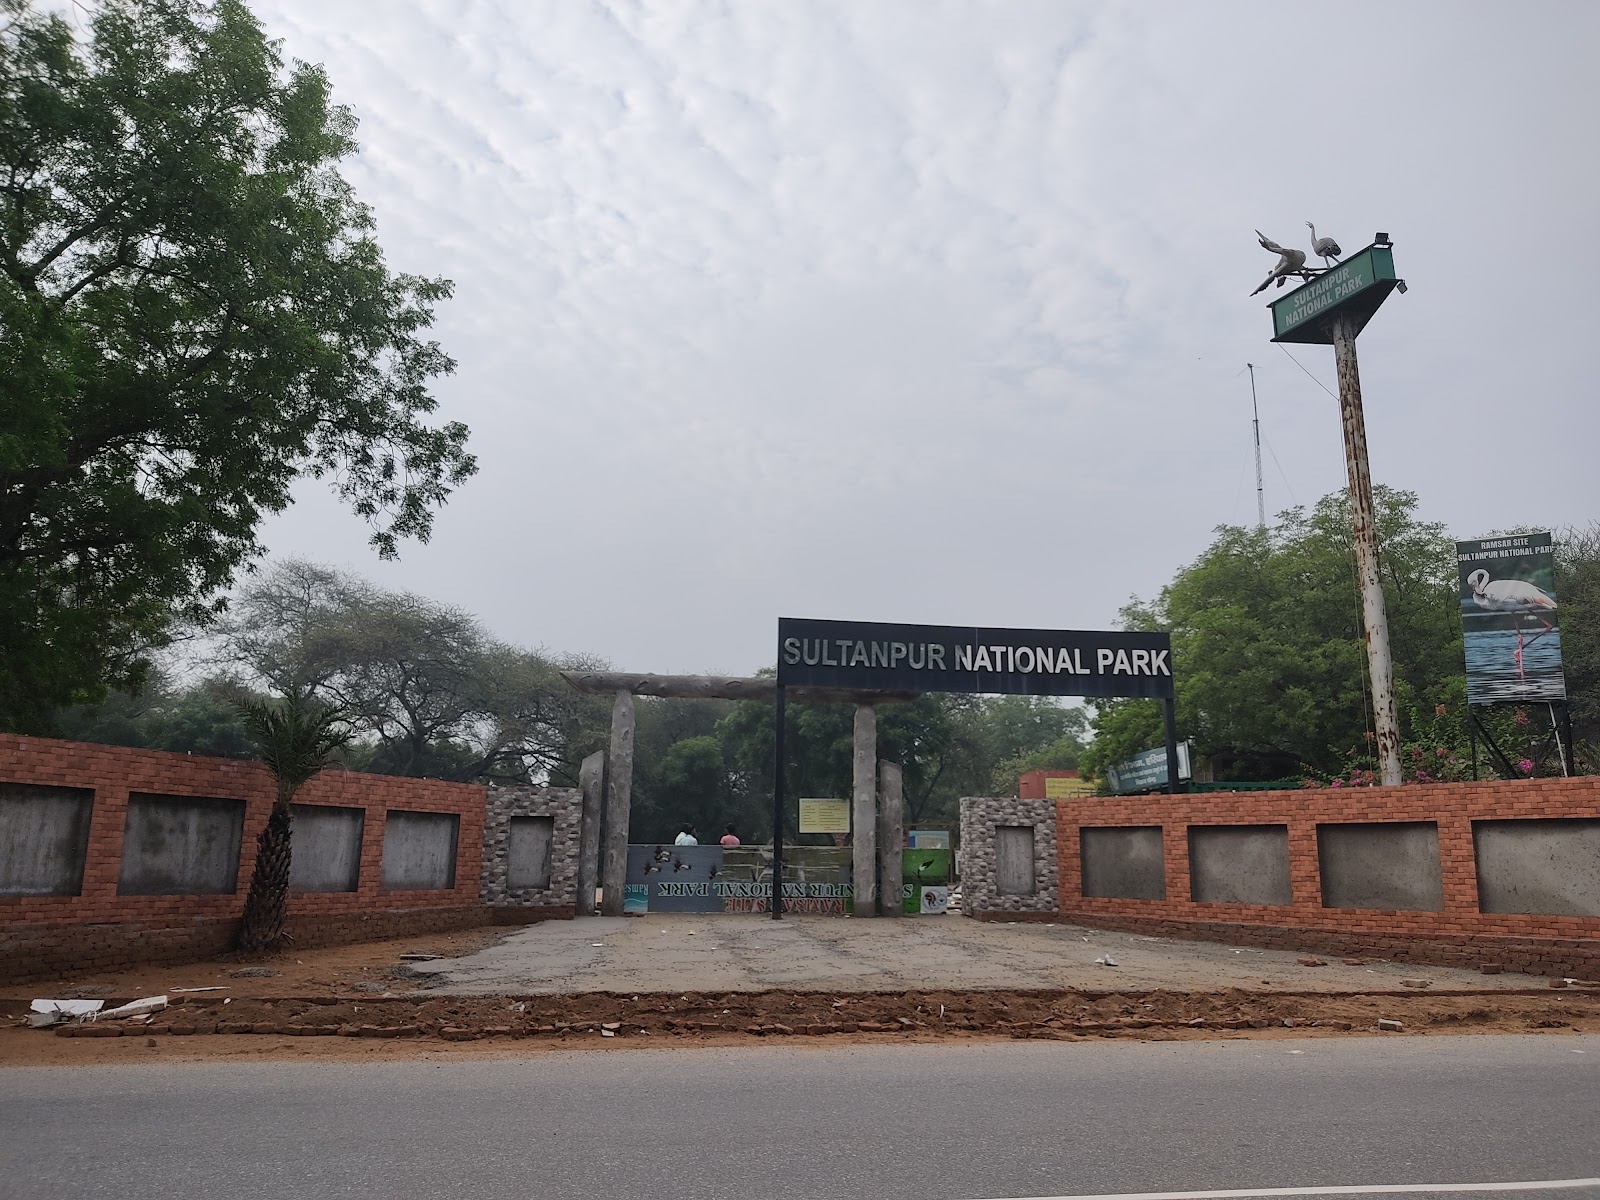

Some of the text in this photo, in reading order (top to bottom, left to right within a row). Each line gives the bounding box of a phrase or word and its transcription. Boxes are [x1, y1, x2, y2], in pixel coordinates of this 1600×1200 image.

[1294, 267, 1349, 308] SULTANPUR
[1285, 274, 1363, 327] NATIONAL PARK
[1481, 537, 1529, 550] RAMSAR SITE
[1458, 550, 1498, 561] SULTANPUR
[1500, 546, 1533, 557] NATIONAL
[783, 637, 1171, 676] SULTANPUR NATIONAL PARK
[658, 881, 709, 897] PARK
[713, 882, 806, 898] NAIONAL
[769, 897, 847, 914] RAMSA
